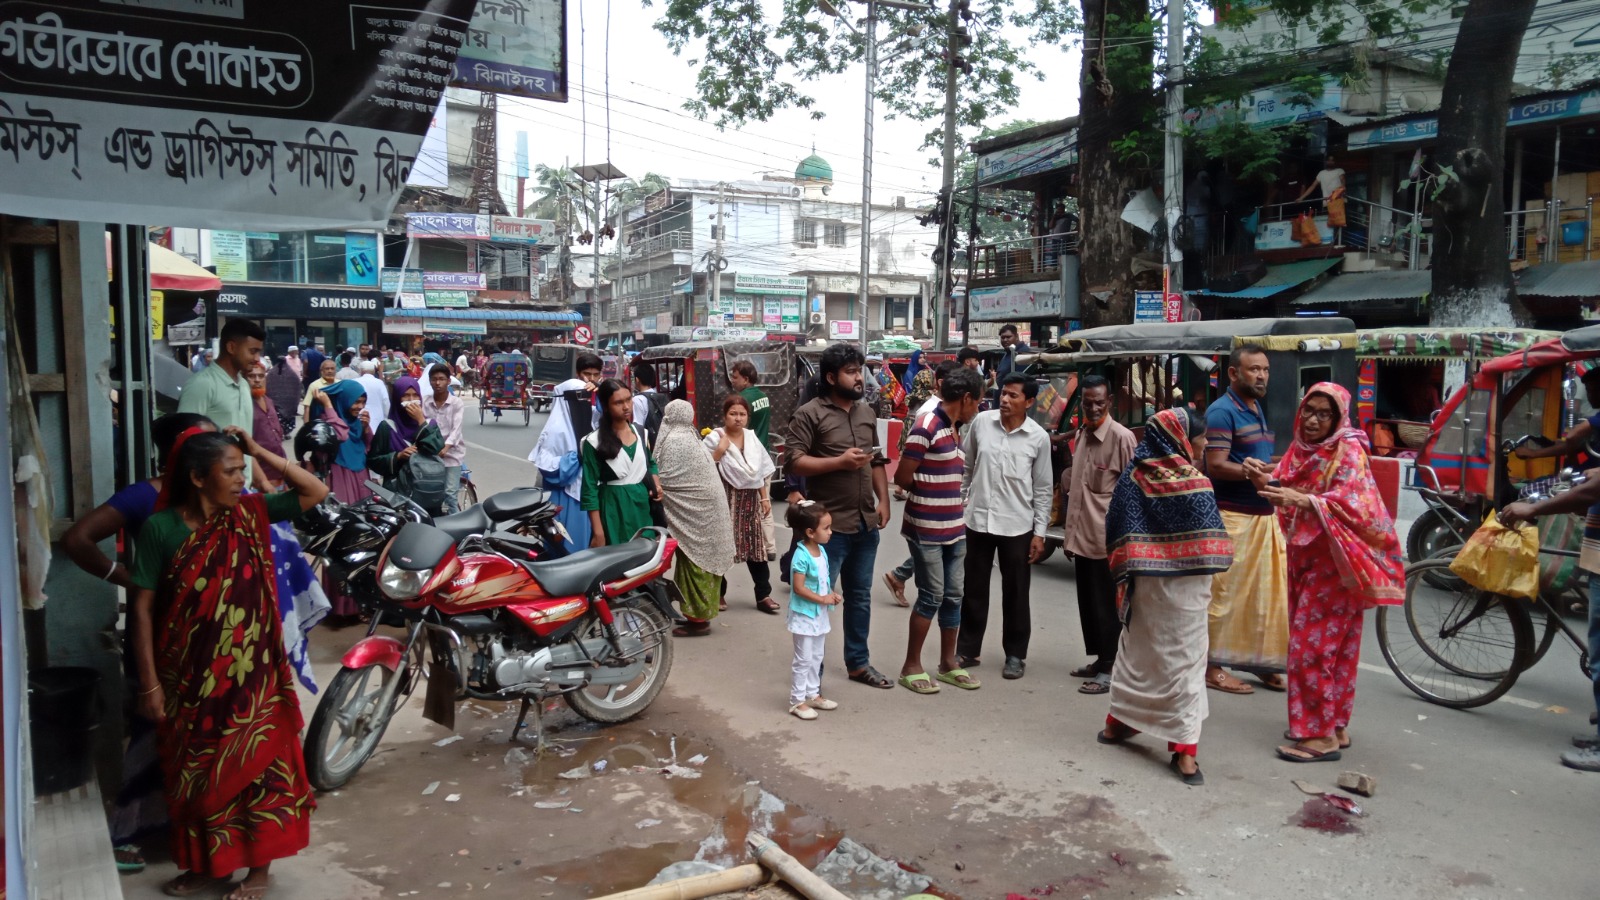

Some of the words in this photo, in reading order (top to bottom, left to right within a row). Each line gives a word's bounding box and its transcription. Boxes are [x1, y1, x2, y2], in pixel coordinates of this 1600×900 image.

[0, 12, 163, 81] গভীরভাবে
[171, 40, 301, 96] শোকাহত
[473, 63, 547, 93] ঝিনাইদহ
[1257, 100, 1276, 116] নিউ
[1381, 123, 1408, 140] নিউ
[1522, 98, 1569, 117] স্টোর
[105, 127, 156, 173] এন্ড
[411, 215, 448, 227] মোহনা
[452, 216, 473, 230] সুজ
[423, 273, 455, 283] মোহনা
[459, 275, 478, 285] সুজ
[217, 293, 248, 305] ামসাং
[310, 297, 377, 310] SAMSUNG
[451, 577, 475, 587] Hero
